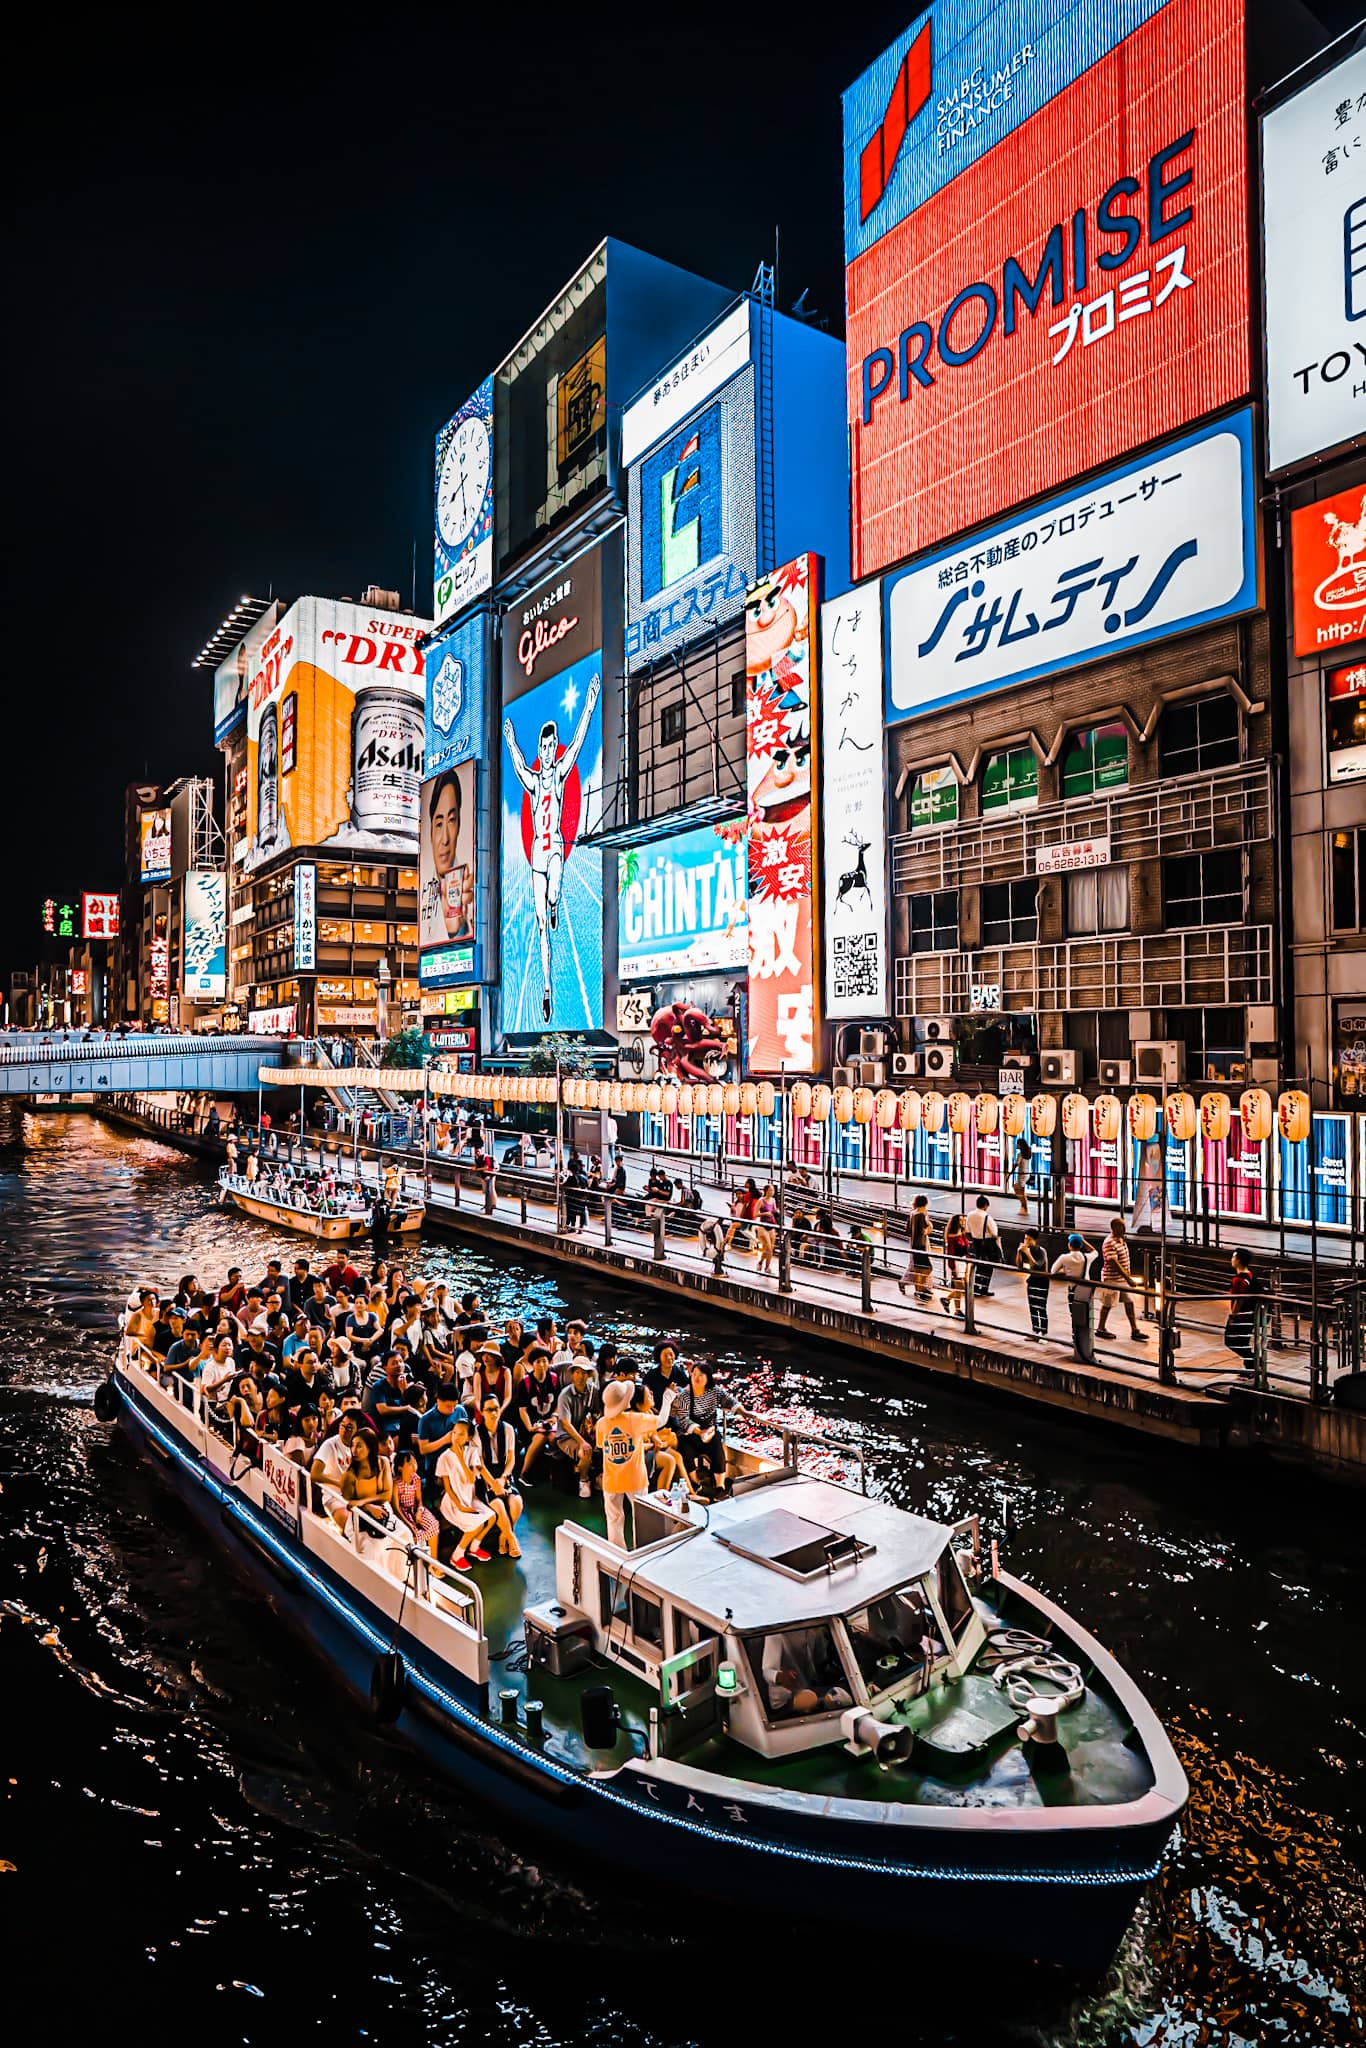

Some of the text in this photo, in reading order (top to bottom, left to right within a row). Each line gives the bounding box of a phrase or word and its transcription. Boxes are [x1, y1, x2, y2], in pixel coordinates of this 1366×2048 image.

[937, 44, 1036, 136] CONSUMER
[937, 66, 983, 119] SMBC
[938, 80, 1014, 156] FINANCE
[863, 127, 1197, 427] PROMISE
[1048, 245, 1196, 367] プロミス
[652, 344, 711, 407] 夢ある住まい
[937, 472, 1183, 591] 総合不動産のプロデューサー
[456, 553, 478, 590] ピップ
[523, 580, 571, 625] おいしさと健康
[625, 564, 748, 659] 日商エステム
[367, 619, 426, 642] SUPER
[832, 610, 874, 750] はちかん
[383, 774, 402, 788] 生
[762, 837, 805, 893] 激安
[1038, 853, 1107, 872] 06-6262-1313
[971, 986, 1000, 1004] BAR
[436, 1033, 467, 1046] LOTTERIA
[1000, 1071, 1023, 1083] BAR
[1240, 1151, 1259, 1161] Street
[1322, 1156, 1343, 1168] Street
[610, 1441, 628, 1456] 100
[637, 1780, 749, 1824] てんま
